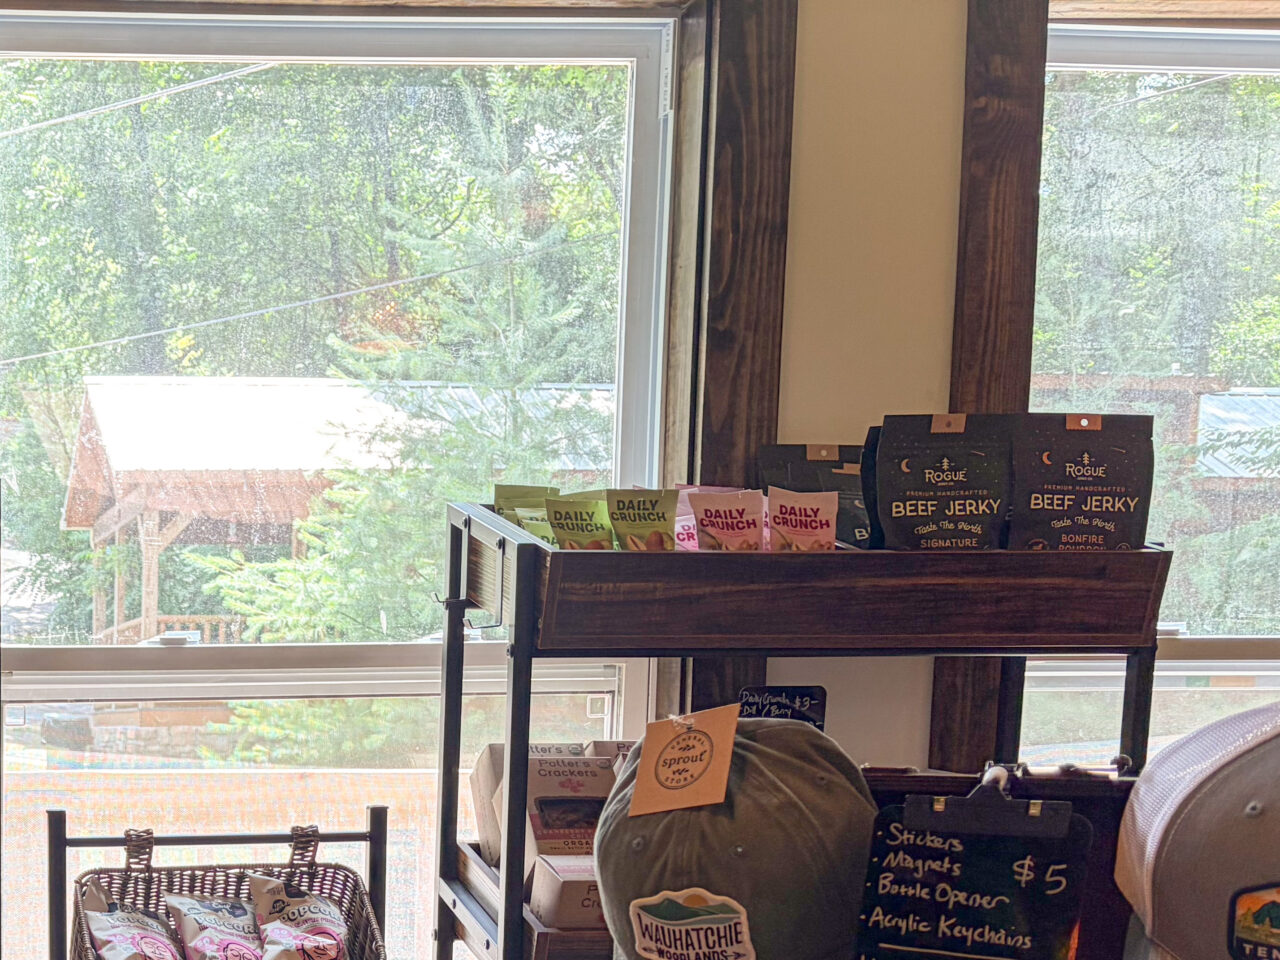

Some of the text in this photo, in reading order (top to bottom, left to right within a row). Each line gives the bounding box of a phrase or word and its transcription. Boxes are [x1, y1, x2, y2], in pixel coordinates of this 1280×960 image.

[616, 499, 659, 511] DAILY
[891, 499, 1001, 517] BEEF JERKY
[1030, 494, 1139, 512] BEEF JERKY
[554, 511, 595, 522] DAILY
[611, 511, 667, 523] CRUNCH
[704, 508, 746, 520] DAILY
[779, 504, 820, 518] DAILY
[700, 518, 757, 531] CRUNCH
[773, 515, 830, 530] CRUNCH
[920, 538, 978, 548] SIGNATURE
[1061, 534, 1104, 544] BONFIRE
[538, 759, 592, 768] Potter's
[662, 750, 707, 769] sprout
[538, 768, 598, 778] Crackers
[886, 823, 964, 851] Stickers
[883, 851, 962, 878] Magnets
[878, 873, 1010, 910] Bottle Opener
[637, 913, 743, 951] WAUHATCHIE
[868, 907, 1032, 949] Acrylic Keychains
